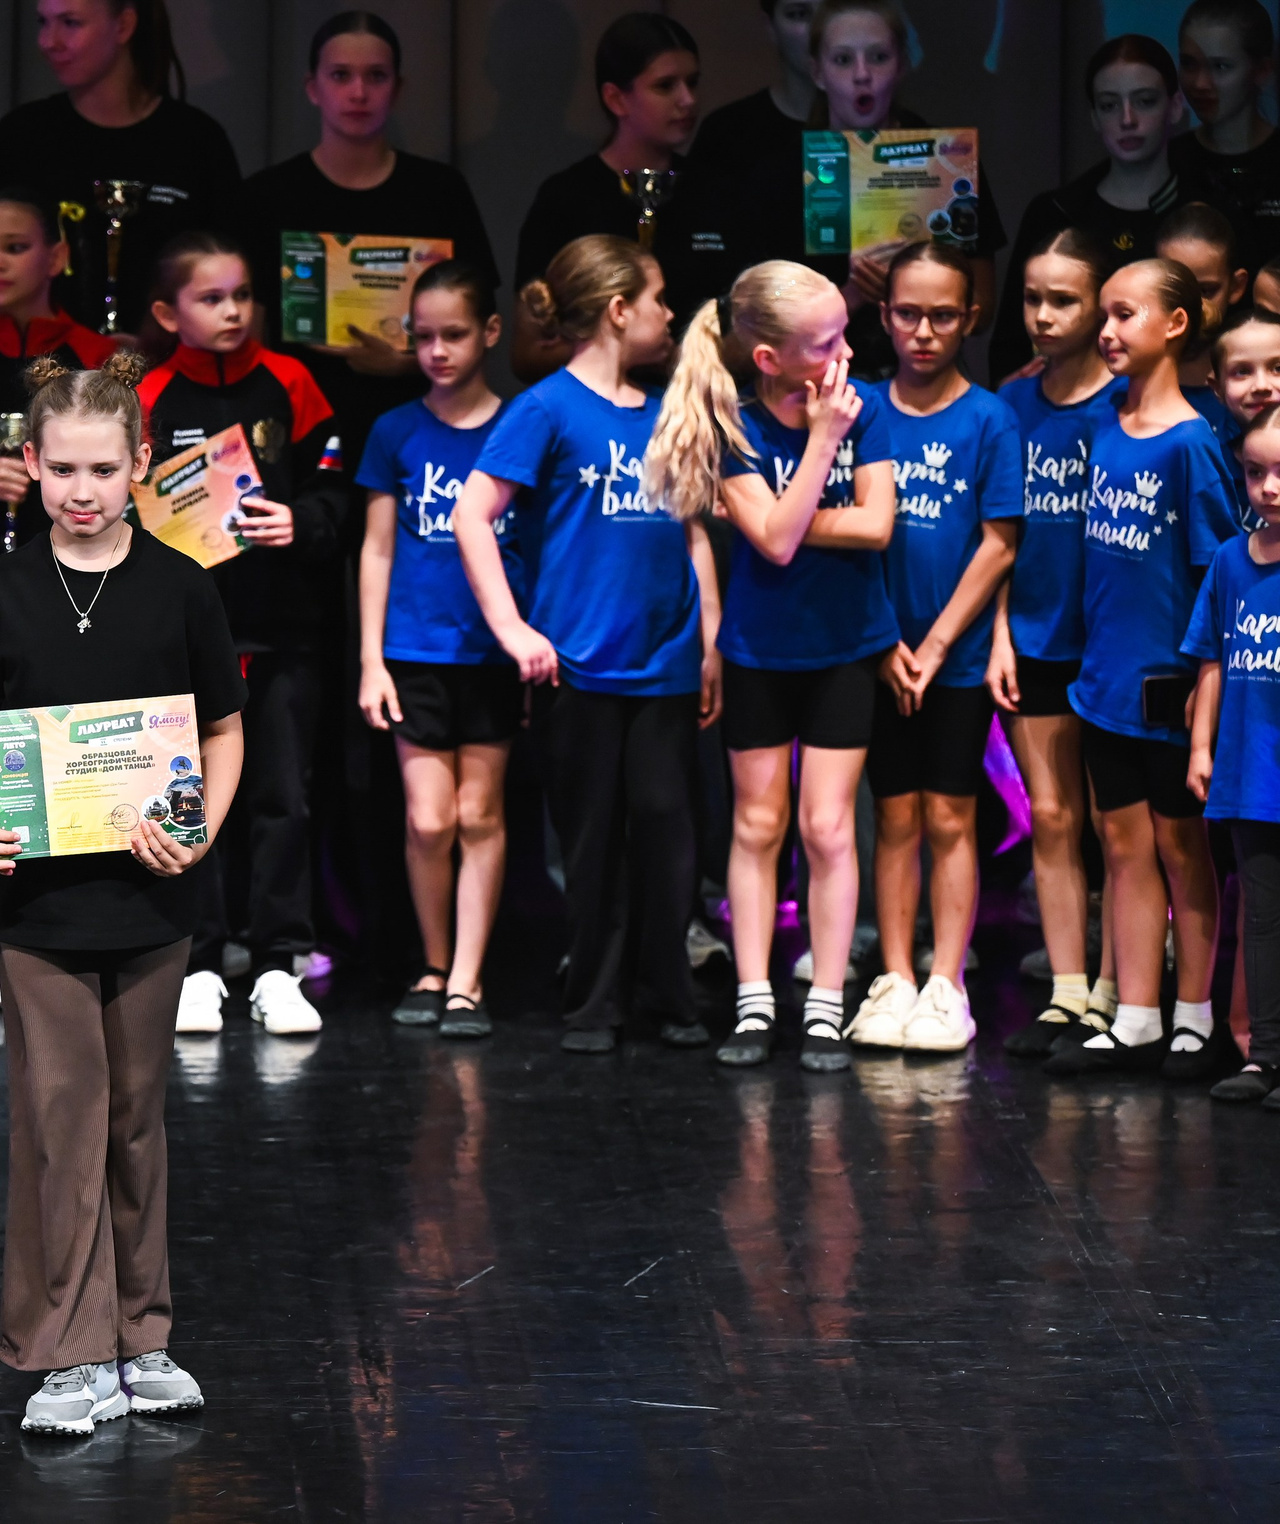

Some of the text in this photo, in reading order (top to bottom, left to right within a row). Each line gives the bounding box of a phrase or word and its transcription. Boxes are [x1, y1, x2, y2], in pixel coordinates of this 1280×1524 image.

[604, 439, 643, 481] Ка
[416, 461, 465, 503] Ка
[77, 716, 135, 736] ЛАУРЕАТ
[66, 754, 153, 769] ХОРЕОГРАФИЧЕСКАЯ
[81, 749, 137, 760] ОБРАЗЦОВАЯ
[65, 762, 155, 775] СТУДИЯ «ДОМ ТАНЦА»
